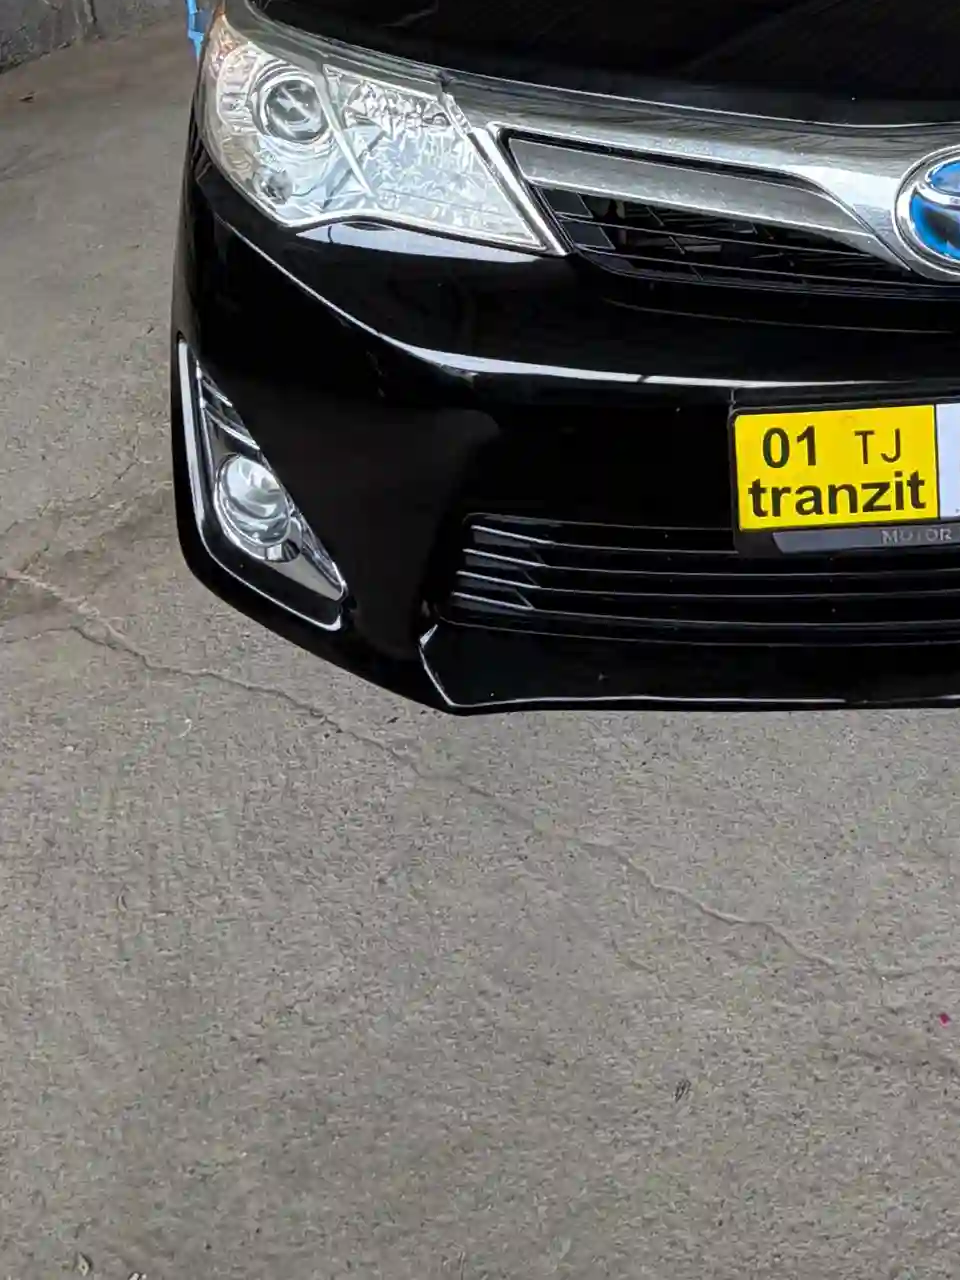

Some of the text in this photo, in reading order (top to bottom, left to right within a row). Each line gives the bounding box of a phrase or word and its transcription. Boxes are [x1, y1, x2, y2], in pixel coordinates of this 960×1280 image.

[761, 425, 902, 469] 01 TJ
[748, 470, 927, 518] tranzit
